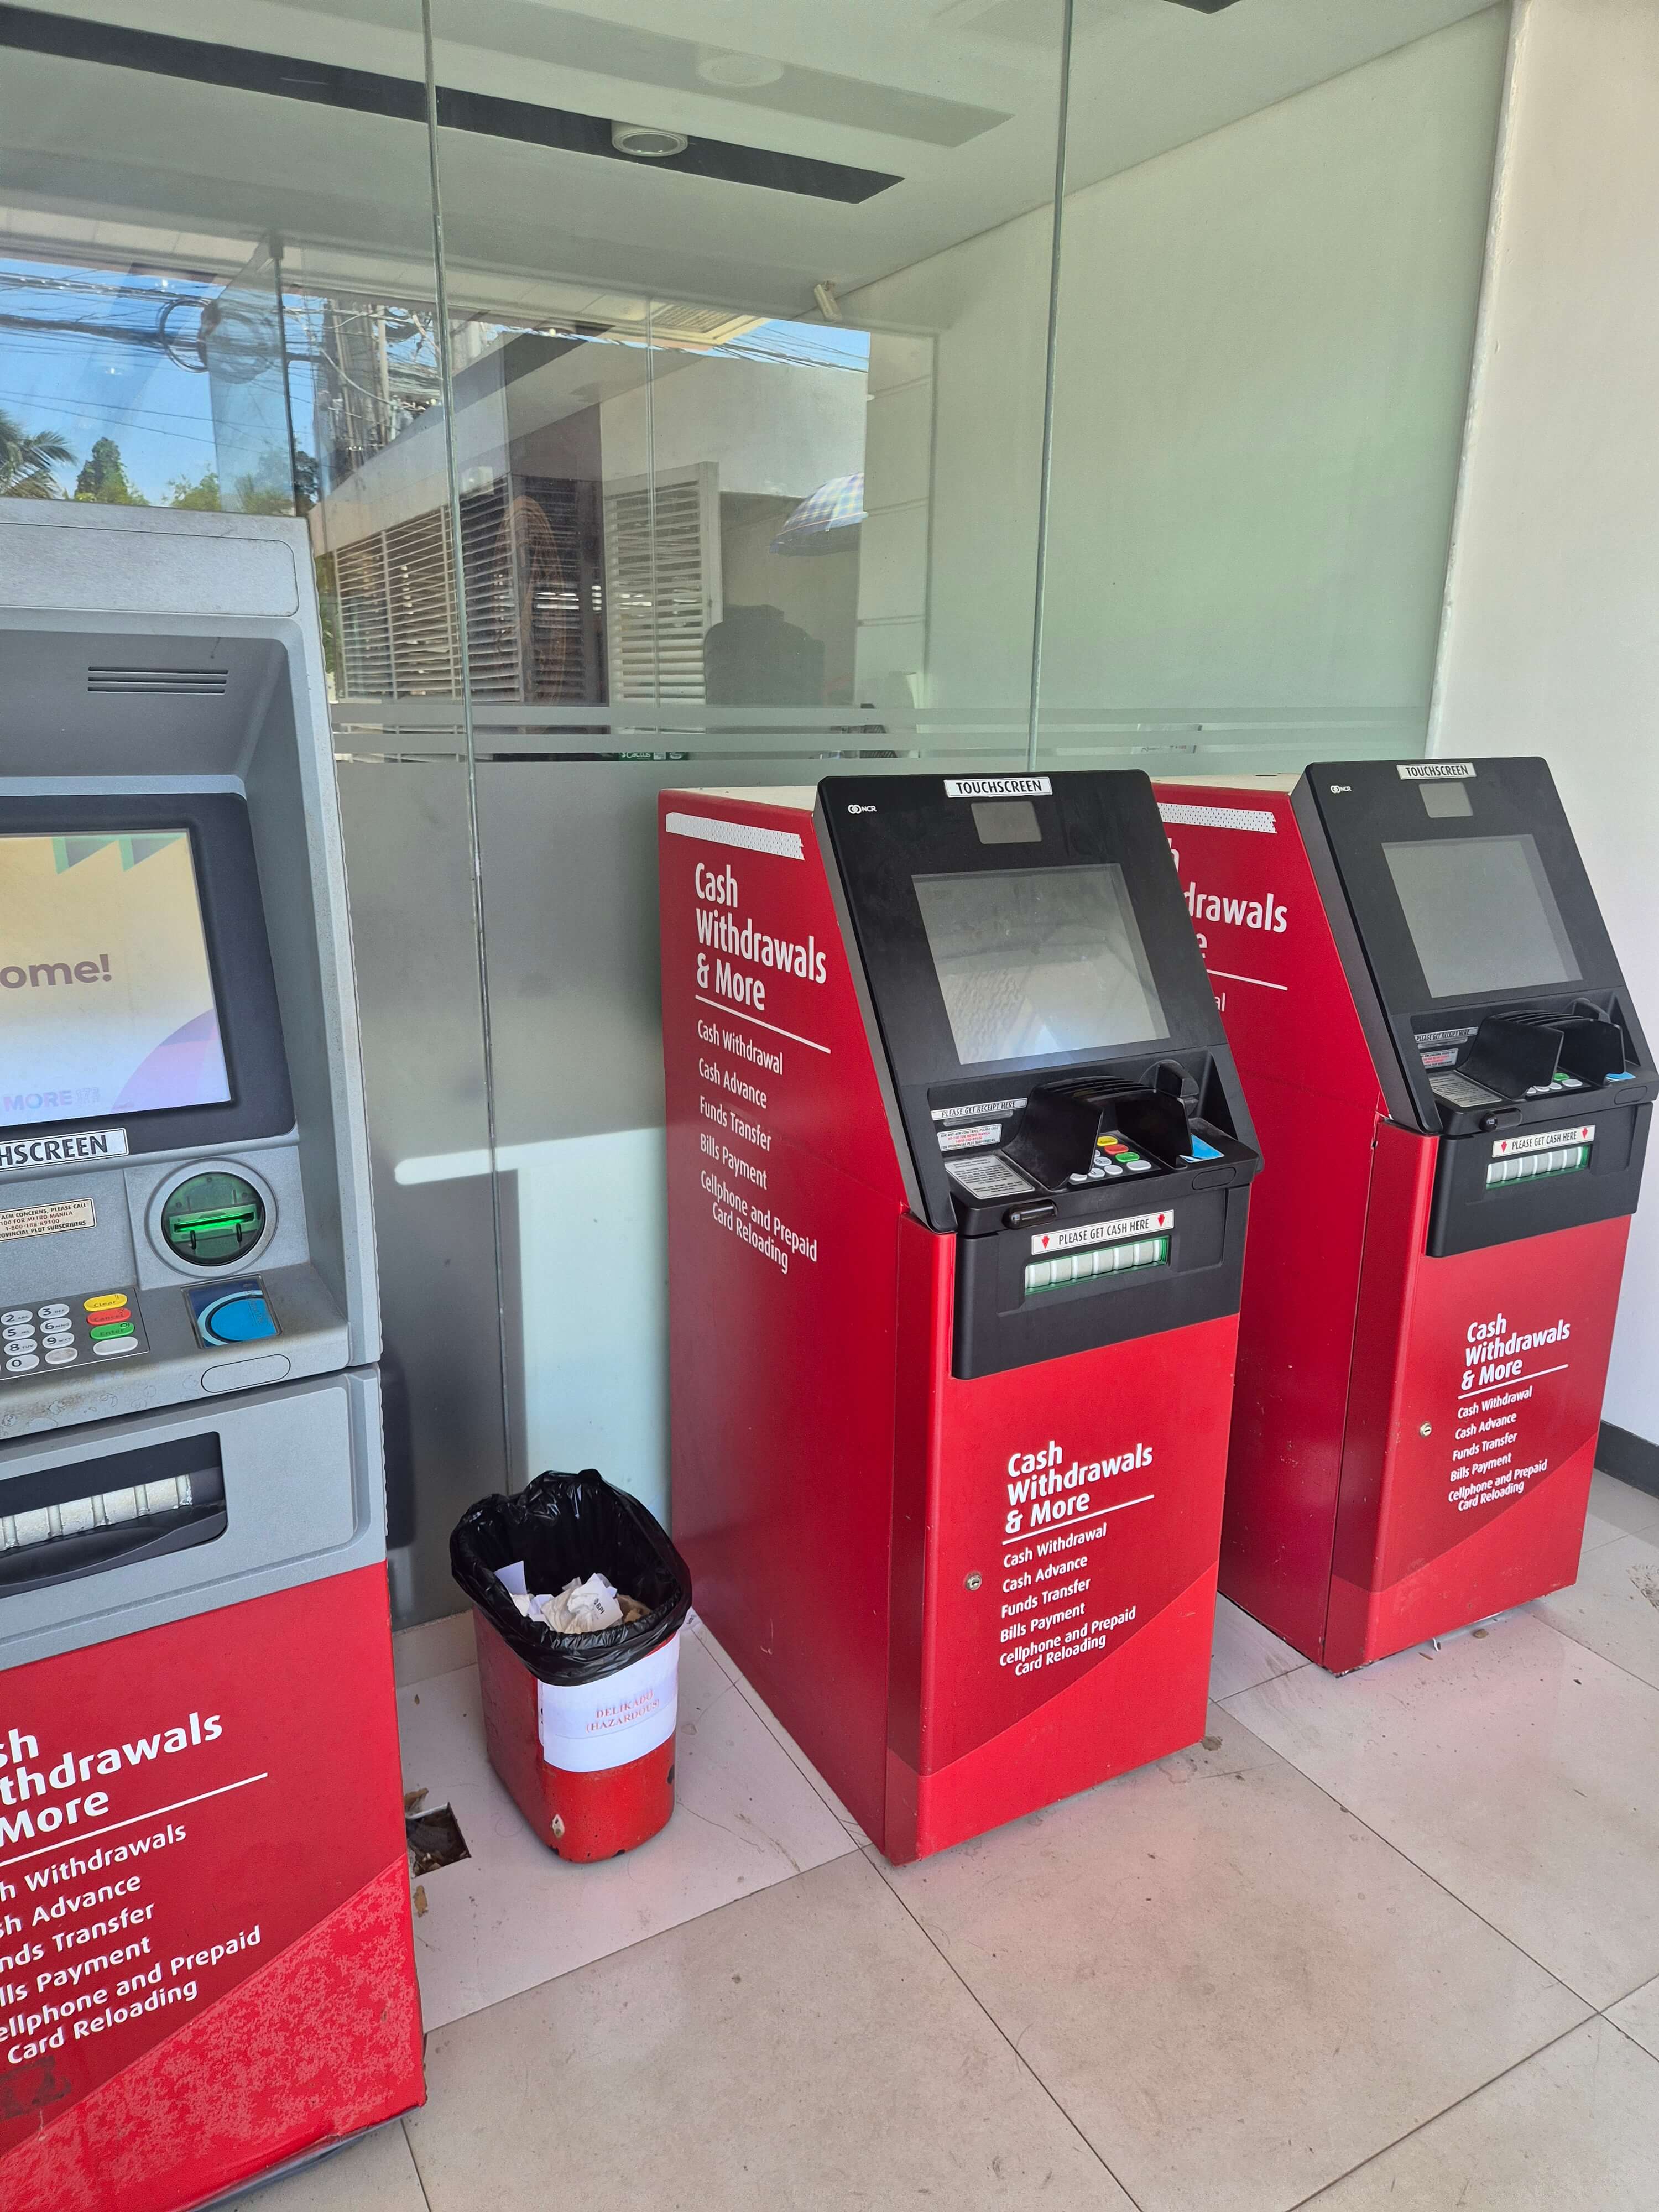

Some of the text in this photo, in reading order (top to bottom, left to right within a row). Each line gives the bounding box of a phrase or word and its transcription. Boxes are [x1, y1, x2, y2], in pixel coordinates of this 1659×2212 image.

[956, 779, 1042, 795] TOUCHSCREEN
[1405, 765, 1469, 777] TOUCHSCREEN
[695, 862, 738, 907] Cash
[696, 907, 827, 984] Withdrawals
[697, 952, 765, 1011] & More
[698, 1019, 783, 1076] Cash Withdrawal
[3, 1090, 72, 1112] MORE
[698, 1057, 766, 1109] Cash Advance
[700, 1095, 771, 1151] Funds Transfer
[942, 1108, 964, 1118] PLEASE
[965, 1106, 975, 1114] GET
[977, 1103, 999, 1113] RECEIPT
[1512, 1131, 1577, 1150] PLEASE GET CASH HERE
[701, 1133, 768, 1190] Bills Payment
[16, 1208, 49, 1218] CONCERNS,
[47, 1220, 86, 1230] SUBSCRIBERS
[701, 1170, 817, 1262] Cellphone and Prepaid
[1059, 1218, 1149, 1245] PLEASE GET CASH HERE
[713, 1202, 788, 1274] Card Reloading
[1465, 1319, 1571, 1367] Withdrawals
[1467, 1313, 1507, 1343] Cash
[1461, 1359, 1523, 1390] & More
[1458, 1385, 1533, 1419] Cash Withdrawal
[1452, 1431, 1517, 1462] Funds Transfer
[1455, 1413, 1517, 1440] Cash Advance
[1008, 1440, 1062, 1478] Cash
[1008, 1443, 1153, 1506] Withdrawals
[1451, 1452, 1512, 1482] Bills Payment
[1448, 1459, 1547, 1503] Cellphone and Prepaid
[1458, 1481, 1524, 1511] Card Reloading
[1005, 1493, 1091, 1534] & More
[1003, 1523, 1107, 1568] Cash Withdrawal
[1002, 1556, 1088, 1593] Cash Advance
[596, 1602, 605, 1614] BPI
[1001, 1578, 1091, 1619] Funds Transfer
[1000, 1603, 1086, 1643] Bills Payment
[1000, 1605, 1136, 1667] Cellphone and Prepaid
[1015, 1635, 1106, 1677] Card Reloading
[596, 1689, 654, 1718] DELIKADO
[0, 1791, 109, 1848] More
[24, 1824, 186, 1892] Withdrawals
[32, 1875, 141, 1927] Advance
[52, 1902, 154, 1952] Transfer
[36, 1937, 151, 1993] Payment
[116, 1963, 162, 1996] and
[170, 1925, 261, 1976] Prepaid
[8, 1980, 198, 2064] Card Reloading
